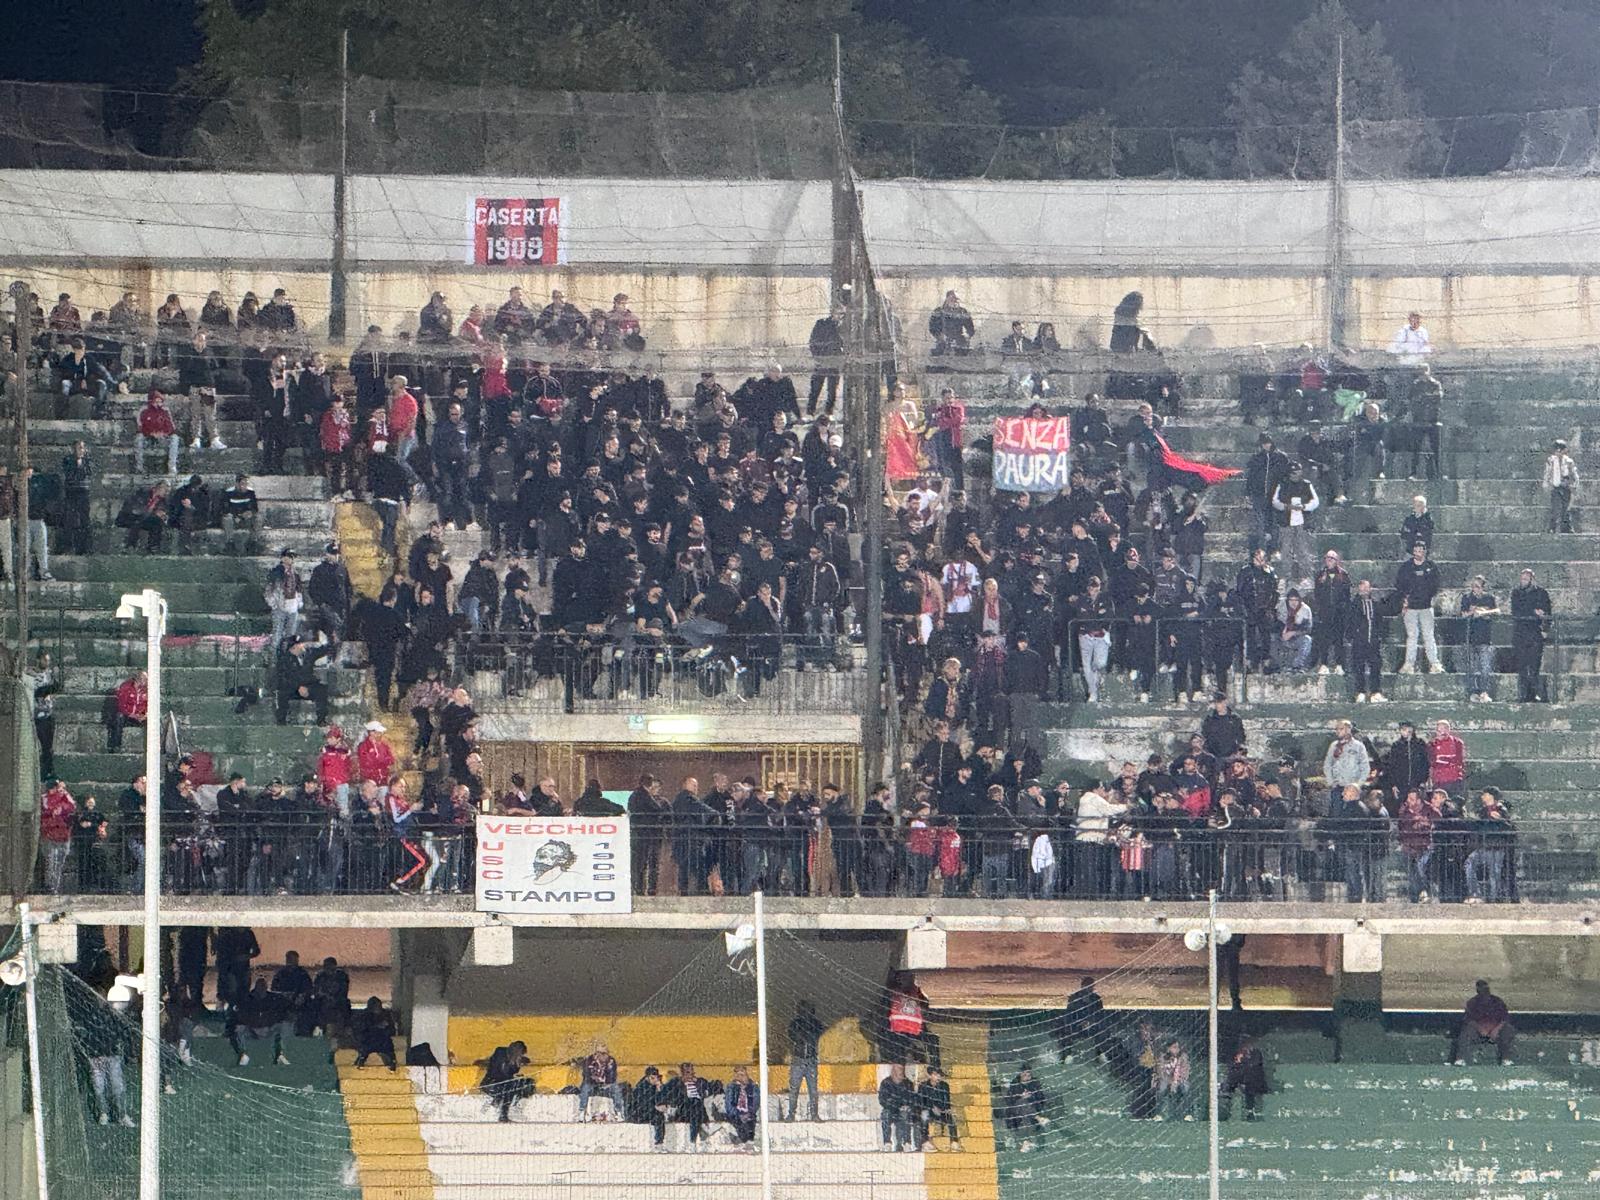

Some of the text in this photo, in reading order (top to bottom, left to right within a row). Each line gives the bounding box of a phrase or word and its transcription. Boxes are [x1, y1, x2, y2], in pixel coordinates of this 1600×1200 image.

[475, 207, 558, 225] CASERTA
[994, 416, 1068, 449] SENZA
[994, 450, 1067, 486] PAURA
[484, 823, 617, 835] VECCHIO
[484, 889, 615, 902] STAMPO
